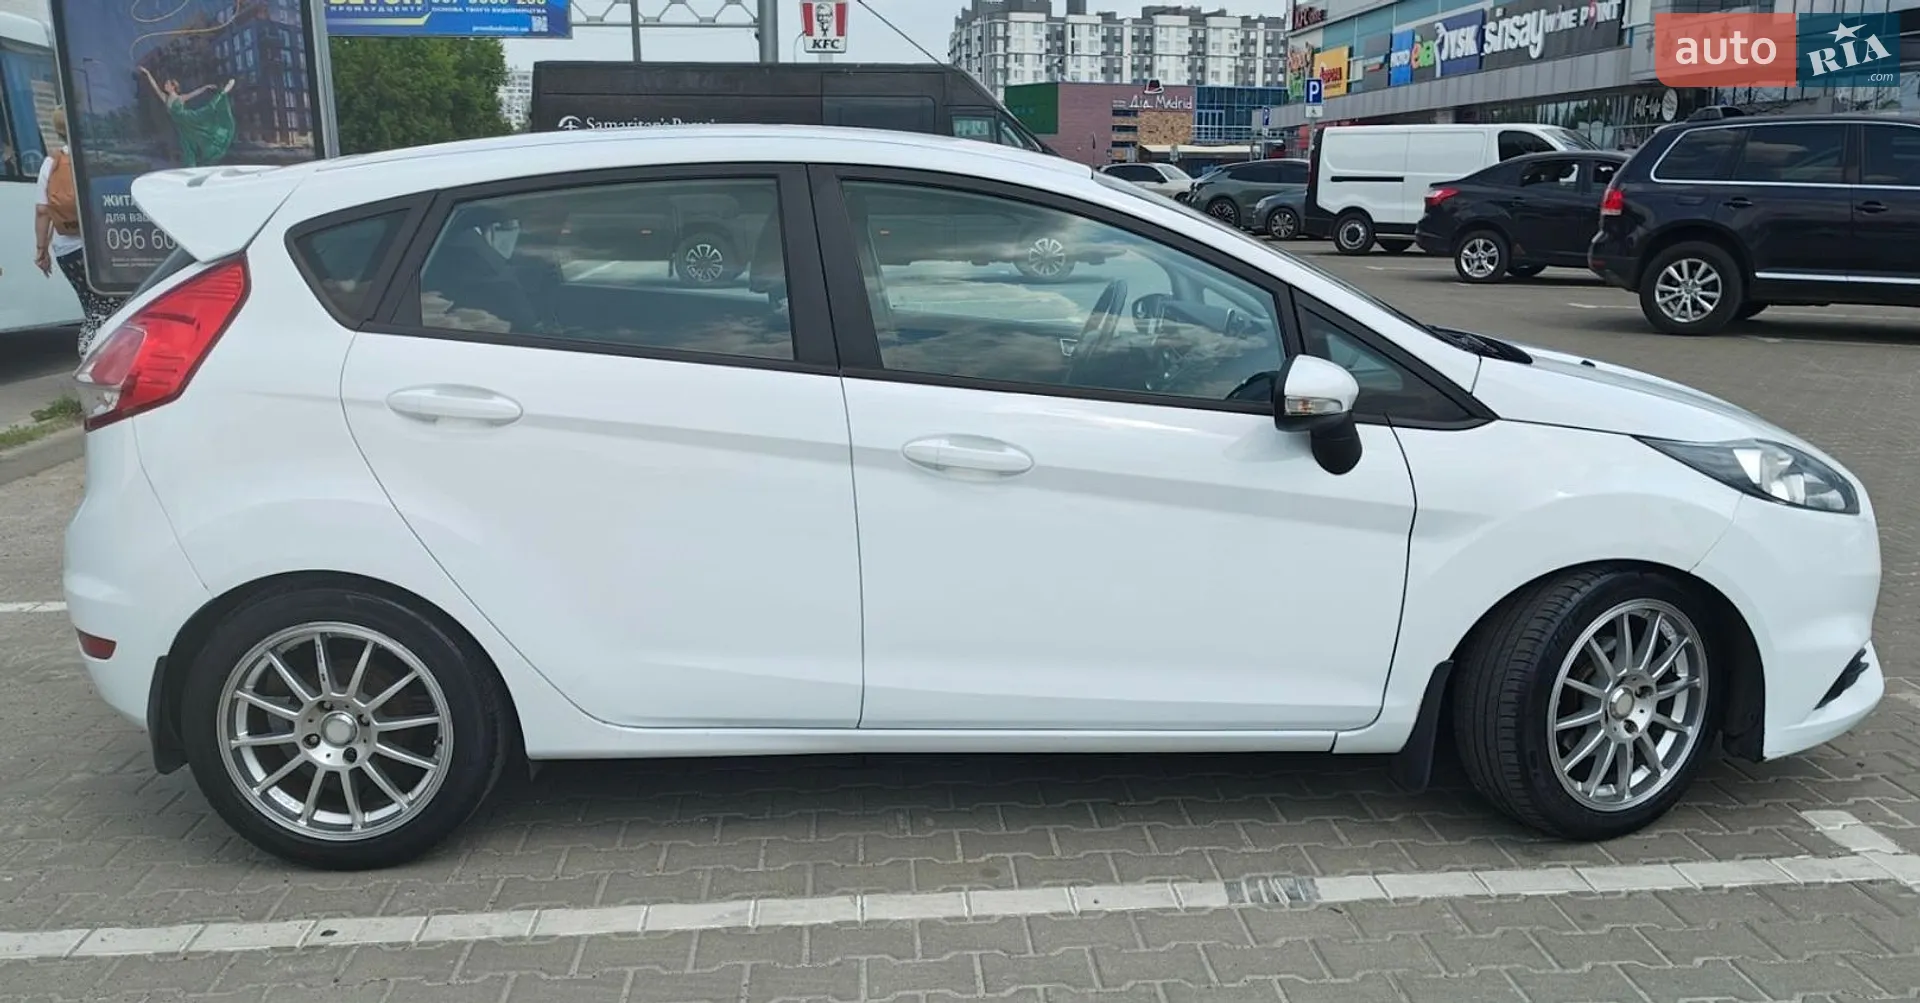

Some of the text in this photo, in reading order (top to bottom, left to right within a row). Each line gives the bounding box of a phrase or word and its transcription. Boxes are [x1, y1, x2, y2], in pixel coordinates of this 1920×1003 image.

[1544, 4, 1578, 33] WINE
[812, 38, 840, 49] KFC
[1440, 24, 1479, 61] JYSK
[1483, 8, 1547, 59] sinsay
[1309, 81, 1319, 102] P
[105, 212, 126, 224] для
[106, 228, 145, 250] 096
